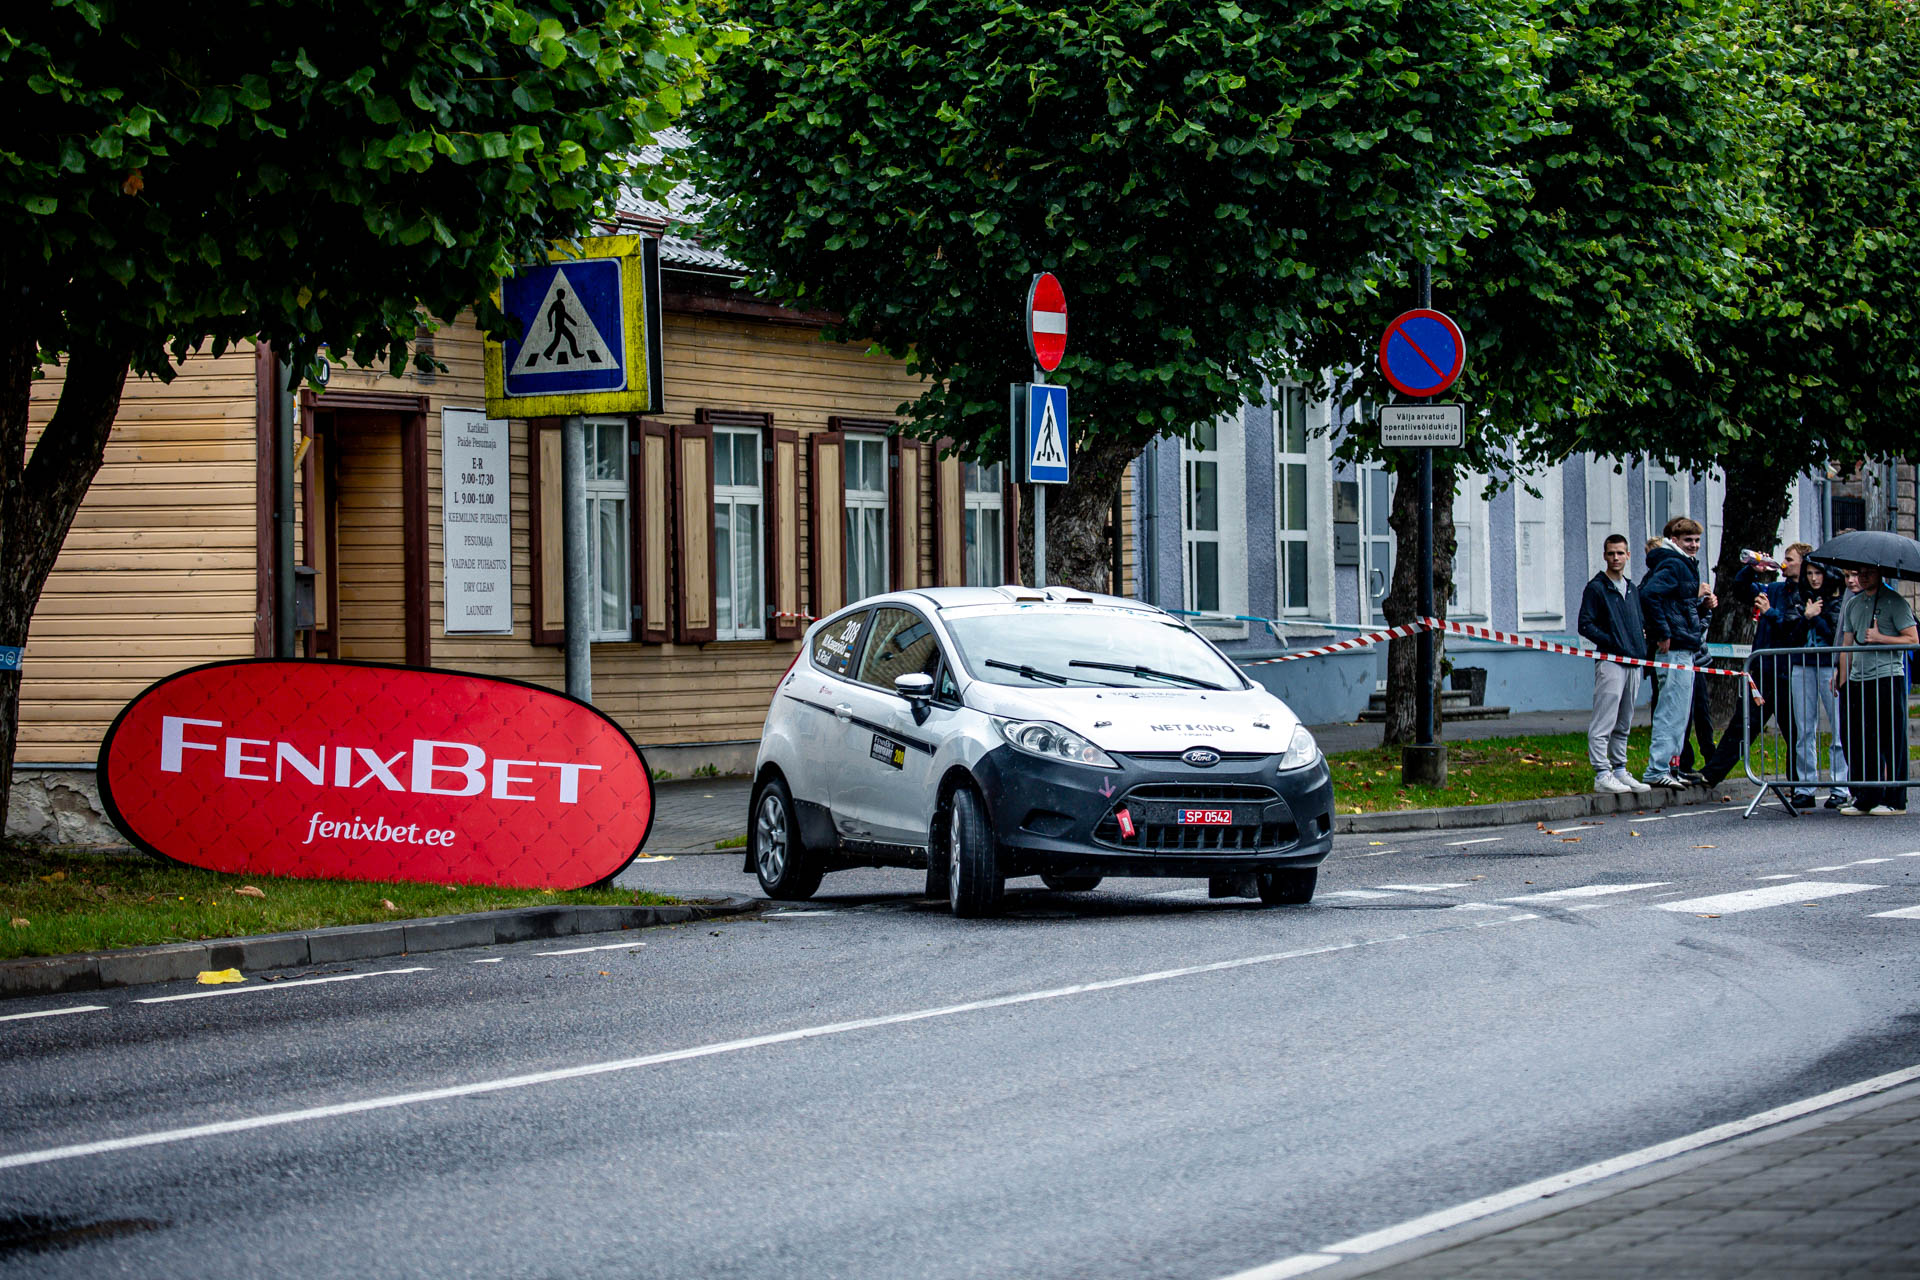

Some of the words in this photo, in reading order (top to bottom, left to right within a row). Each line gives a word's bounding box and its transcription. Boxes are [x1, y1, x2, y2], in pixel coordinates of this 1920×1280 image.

[1396, 413, 1414, 422] Välja
[1450, 424, 1458, 432] ja
[457, 436, 472, 446] Paide
[472, 438, 496, 450] Pesumaja
[472, 458, 483, 470] E-R
[462, 473, 494, 486] 9.00-17.30
[454, 492, 458, 504] L
[462, 493, 494, 504] 9.00-11.00
[448, 513, 478, 522] KEEMILINE
[480, 514, 508, 524] PUHASTUS
[464, 536, 492, 547] PESUMAJA
[451, 559, 476, 568] VAIPADE
[478, 560, 506, 570] PUHASTUS
[464, 582, 476, 592] DRY
[476, 582, 494, 592] CLEAN
[466, 606, 492, 616] LAUNDRY
[840, 620, 861, 642] 208
[1190, 752, 1212, 762] Ford
[1186, 812, 1202, 822] SP
[1204, 812, 1230, 822] 0542
[302, 811, 456, 848] fenixbet.ee
